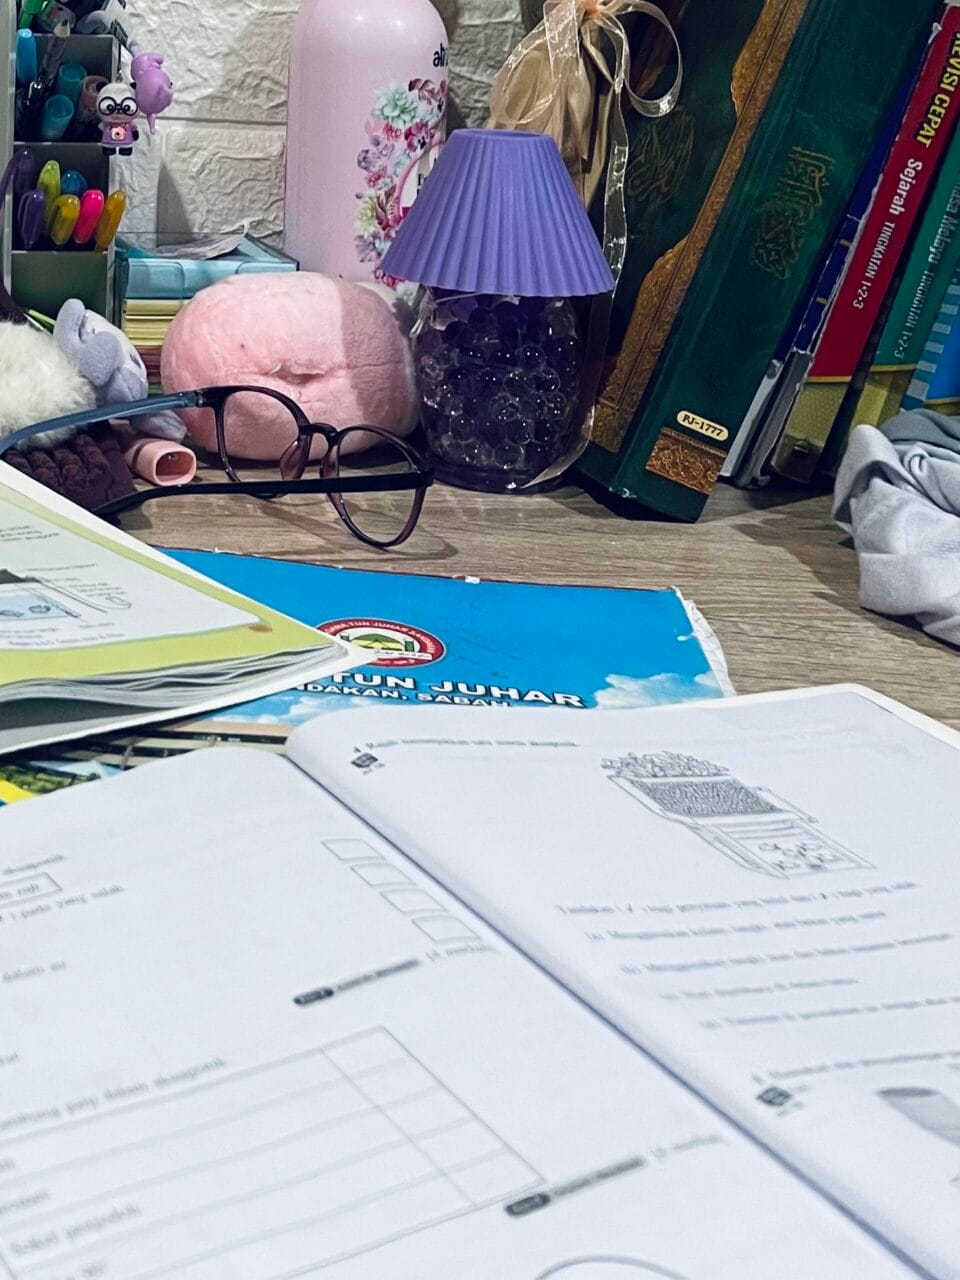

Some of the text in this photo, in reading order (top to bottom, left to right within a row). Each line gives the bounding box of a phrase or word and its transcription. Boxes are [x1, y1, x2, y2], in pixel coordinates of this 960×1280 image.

[916, 93, 951, 149] CEPAT
[889, 158, 923, 216] Sejarah
[864, 221, 896, 280] TINGKATAN
[904, 270, 935, 332] TINGKATAN
[682, 415, 723, 436] RJ-1777
[331, 670, 586, 707] TUN JUHAR
